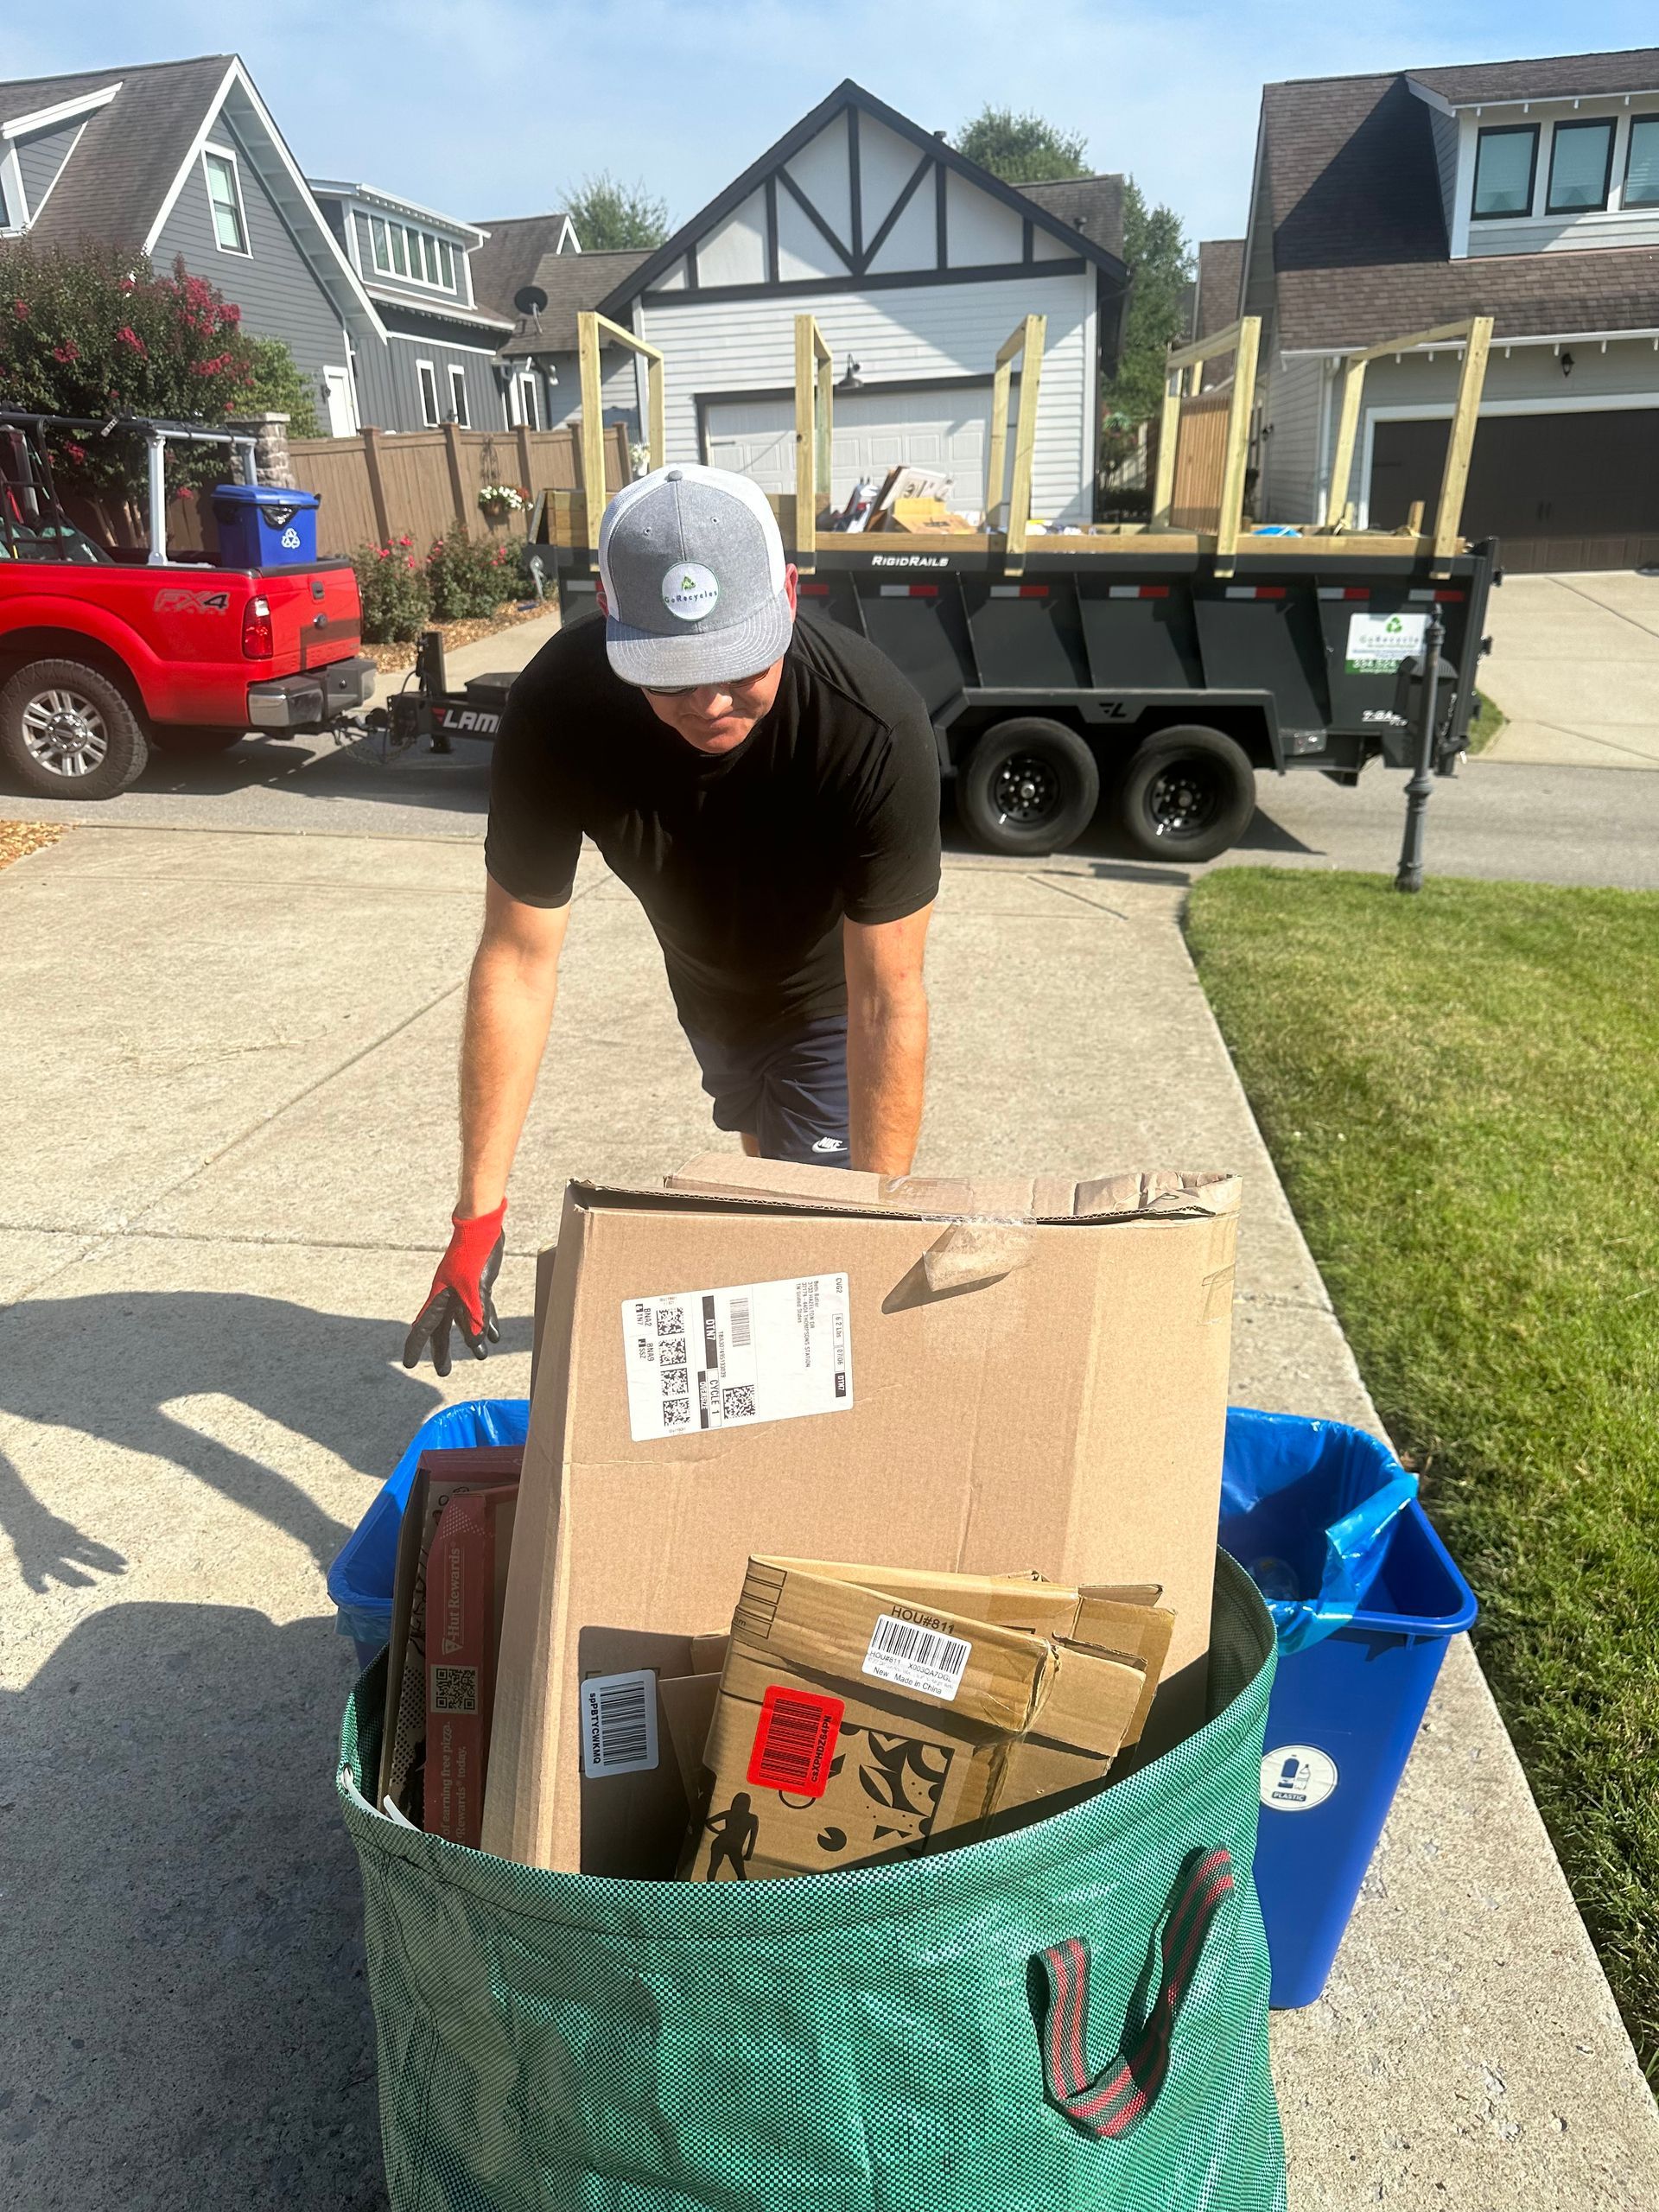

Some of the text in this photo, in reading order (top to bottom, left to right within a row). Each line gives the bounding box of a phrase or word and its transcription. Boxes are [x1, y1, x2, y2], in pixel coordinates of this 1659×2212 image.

[153, 588, 231, 612] FX4
[442, 709, 502, 734] LAM
[818, 1136, 843, 1149] NIKE
[643, 1307, 652, 1326] BNA2
[705, 1318, 716, 1341] DTN7
[646, 1343, 655, 1362] BNA9
[709, 1379, 720, 1406] CYCLE
[836, 1375, 845, 1391] DTN7
[891, 1605, 955, 1635] HOU#811
[873, 1666, 890, 1678] New
[893, 1673, 913, 1687] Made
[922, 1681, 942, 1694] China
[588, 1692, 601, 1765] spPBTYCWKMQ
[441, 1754, 451, 1777] free
[441, 1777, 453, 1822] earning
[1272, 1791, 1306, 1802] PLASTIC
[441, 1821, 450, 1835] of
